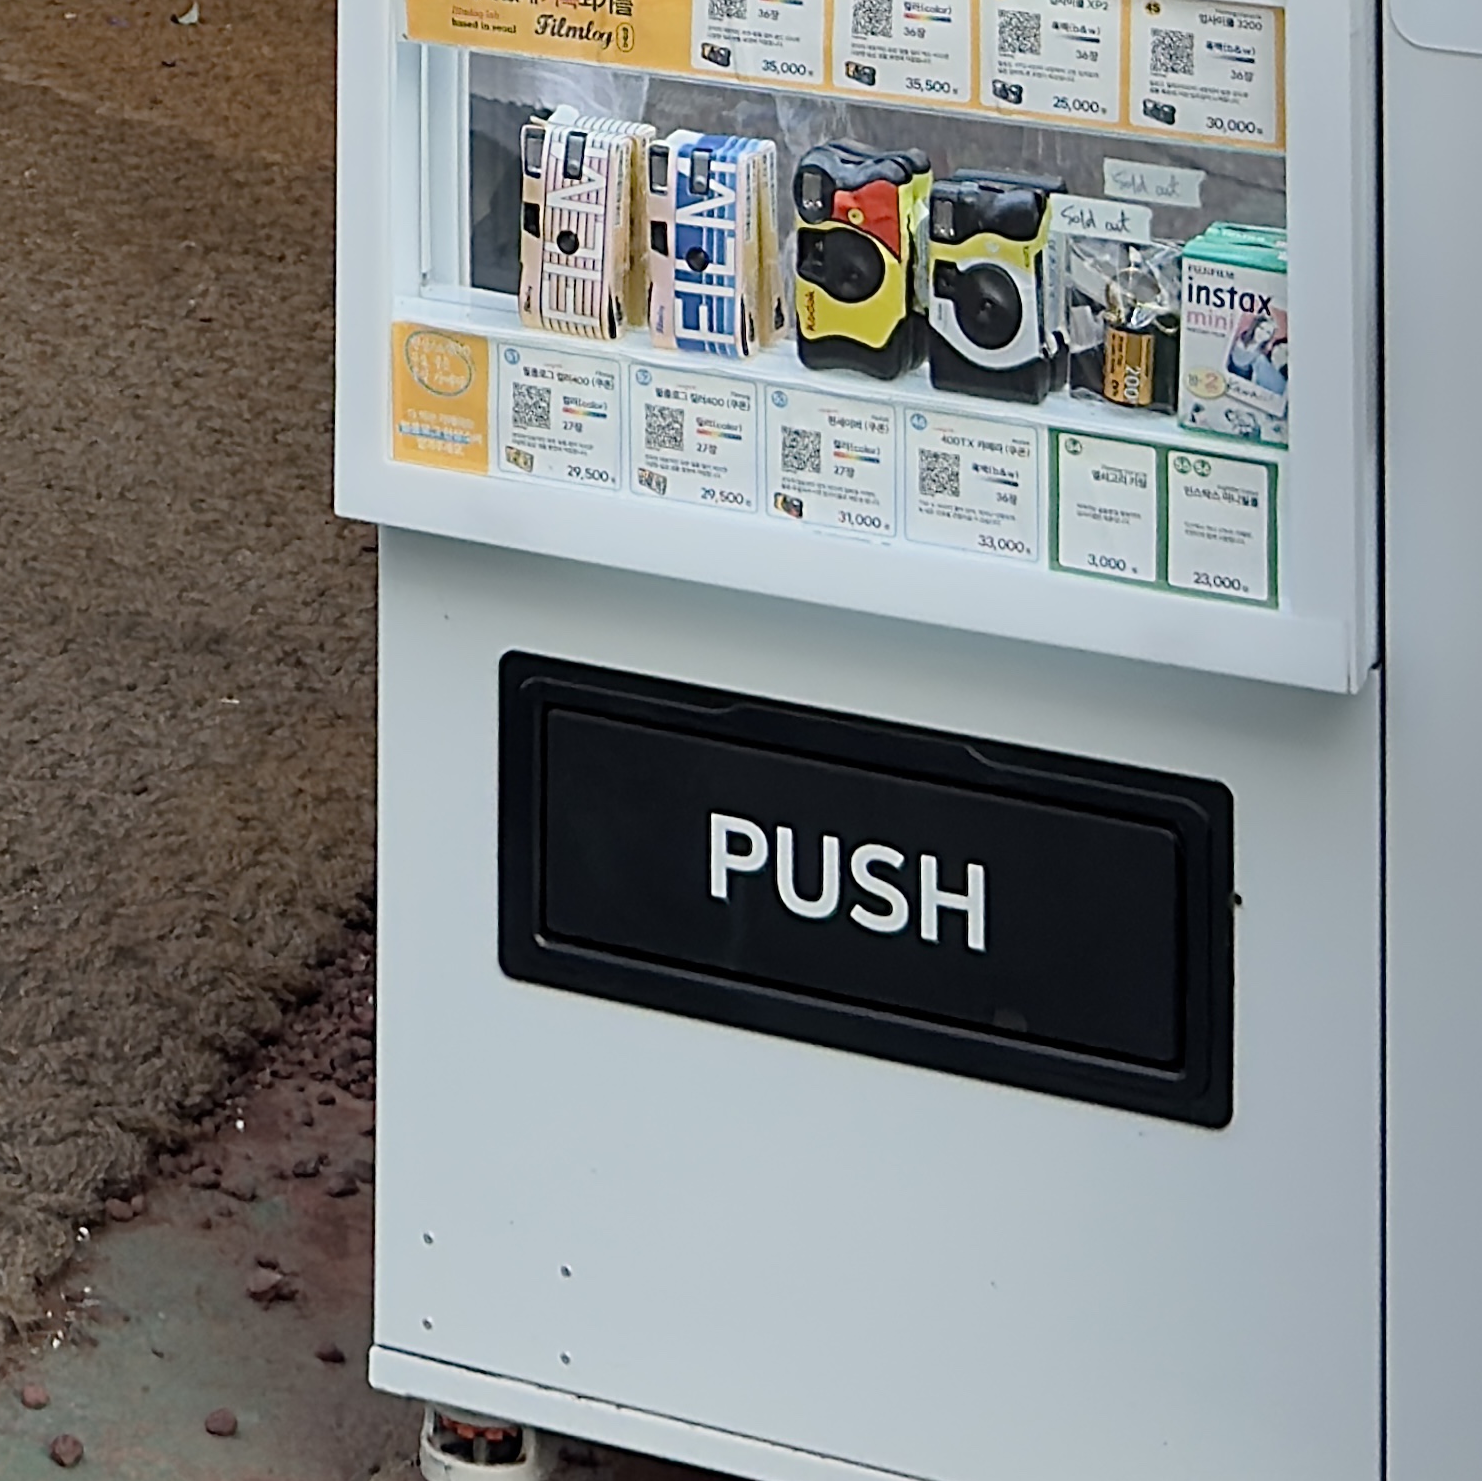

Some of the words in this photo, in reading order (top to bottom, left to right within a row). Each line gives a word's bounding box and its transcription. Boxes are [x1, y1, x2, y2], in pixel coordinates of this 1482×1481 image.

[480, 21, 490, 31] in
[534, 13, 615, 49] Filmlog
[1236, 19, 1263, 32] 3200
[542, 141, 608, 328] FILM
[1061, 205, 1097, 229] Sold
[1105, 209, 1131, 233] out
[675, 156, 737, 346] FILM
[806, 290, 816, 332] Kodak
[1187, 276, 1273, 317] instax
[1186, 308, 1235, 330] mini
[710, 812, 985, 952] PUSH
